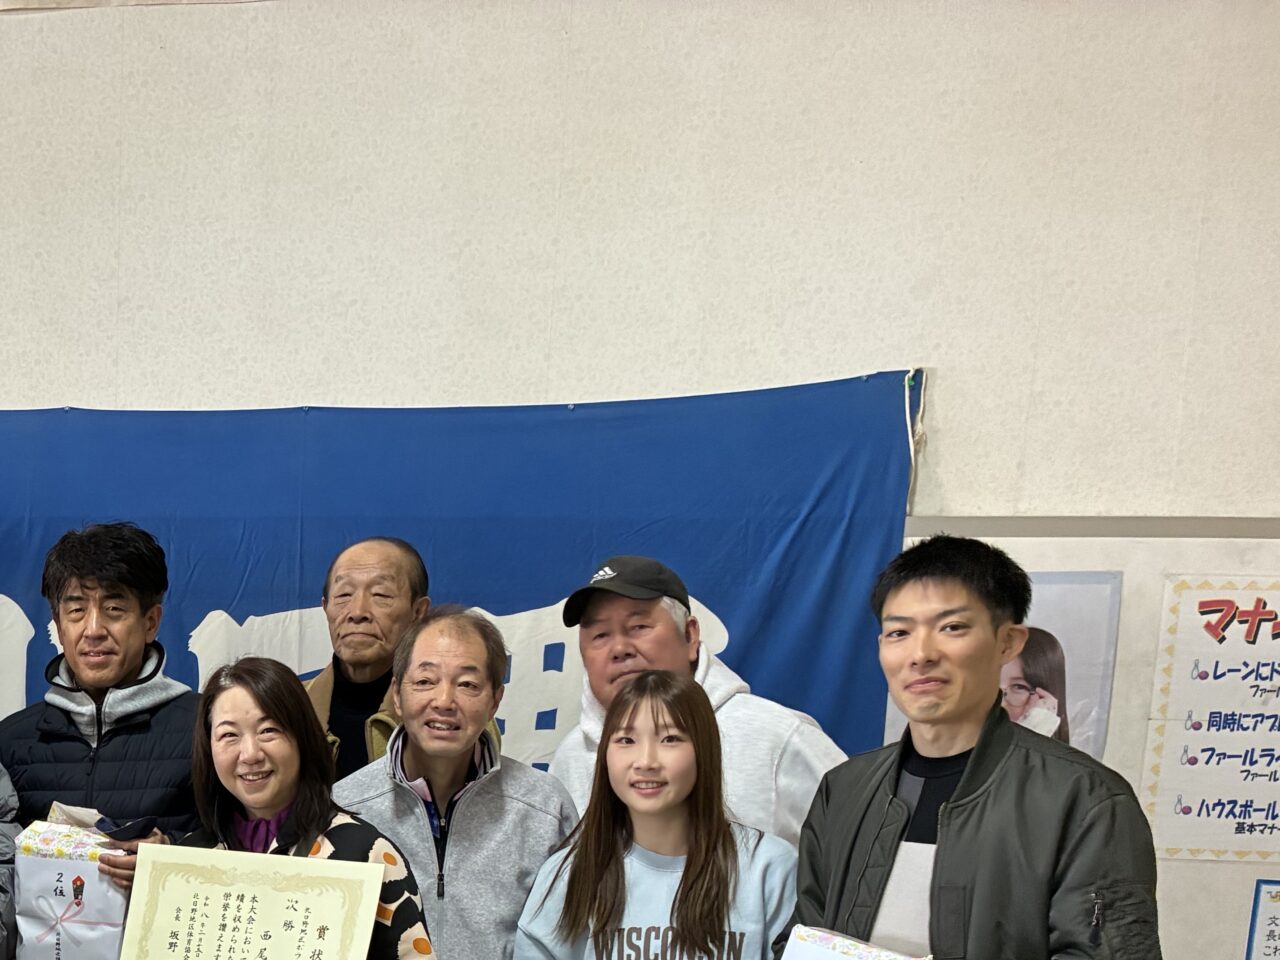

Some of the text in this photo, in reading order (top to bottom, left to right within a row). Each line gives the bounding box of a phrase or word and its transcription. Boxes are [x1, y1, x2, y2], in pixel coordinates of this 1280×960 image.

[1206, 711, 1280, 733] 同時にアプ
[53, 872, 67, 898] 2位
